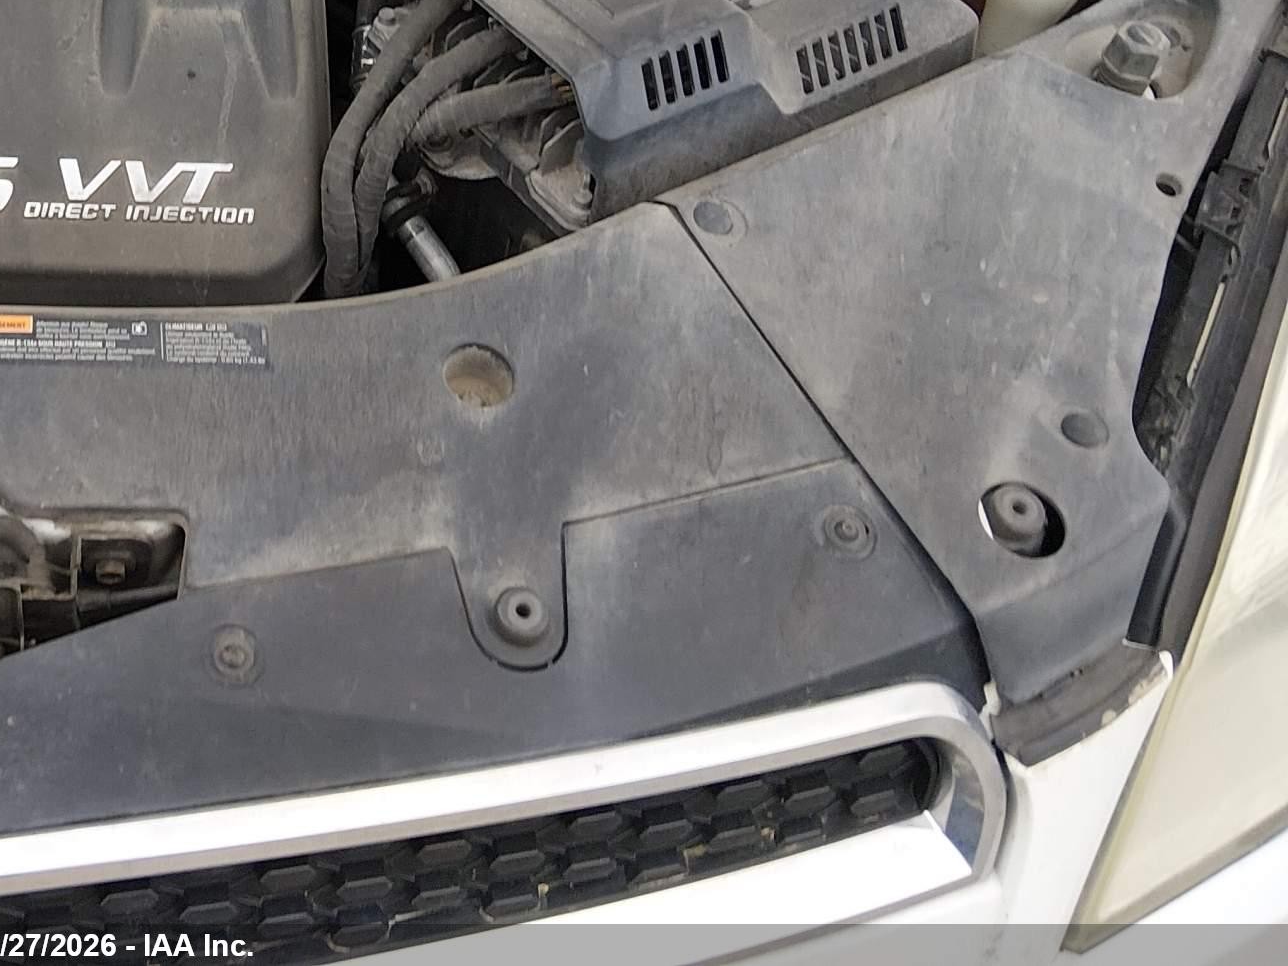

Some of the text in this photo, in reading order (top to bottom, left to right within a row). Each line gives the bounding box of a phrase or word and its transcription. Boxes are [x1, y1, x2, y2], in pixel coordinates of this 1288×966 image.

[58, 157, 234, 204] VVT
[23, 200, 256, 225] DIRECT INJECTION
